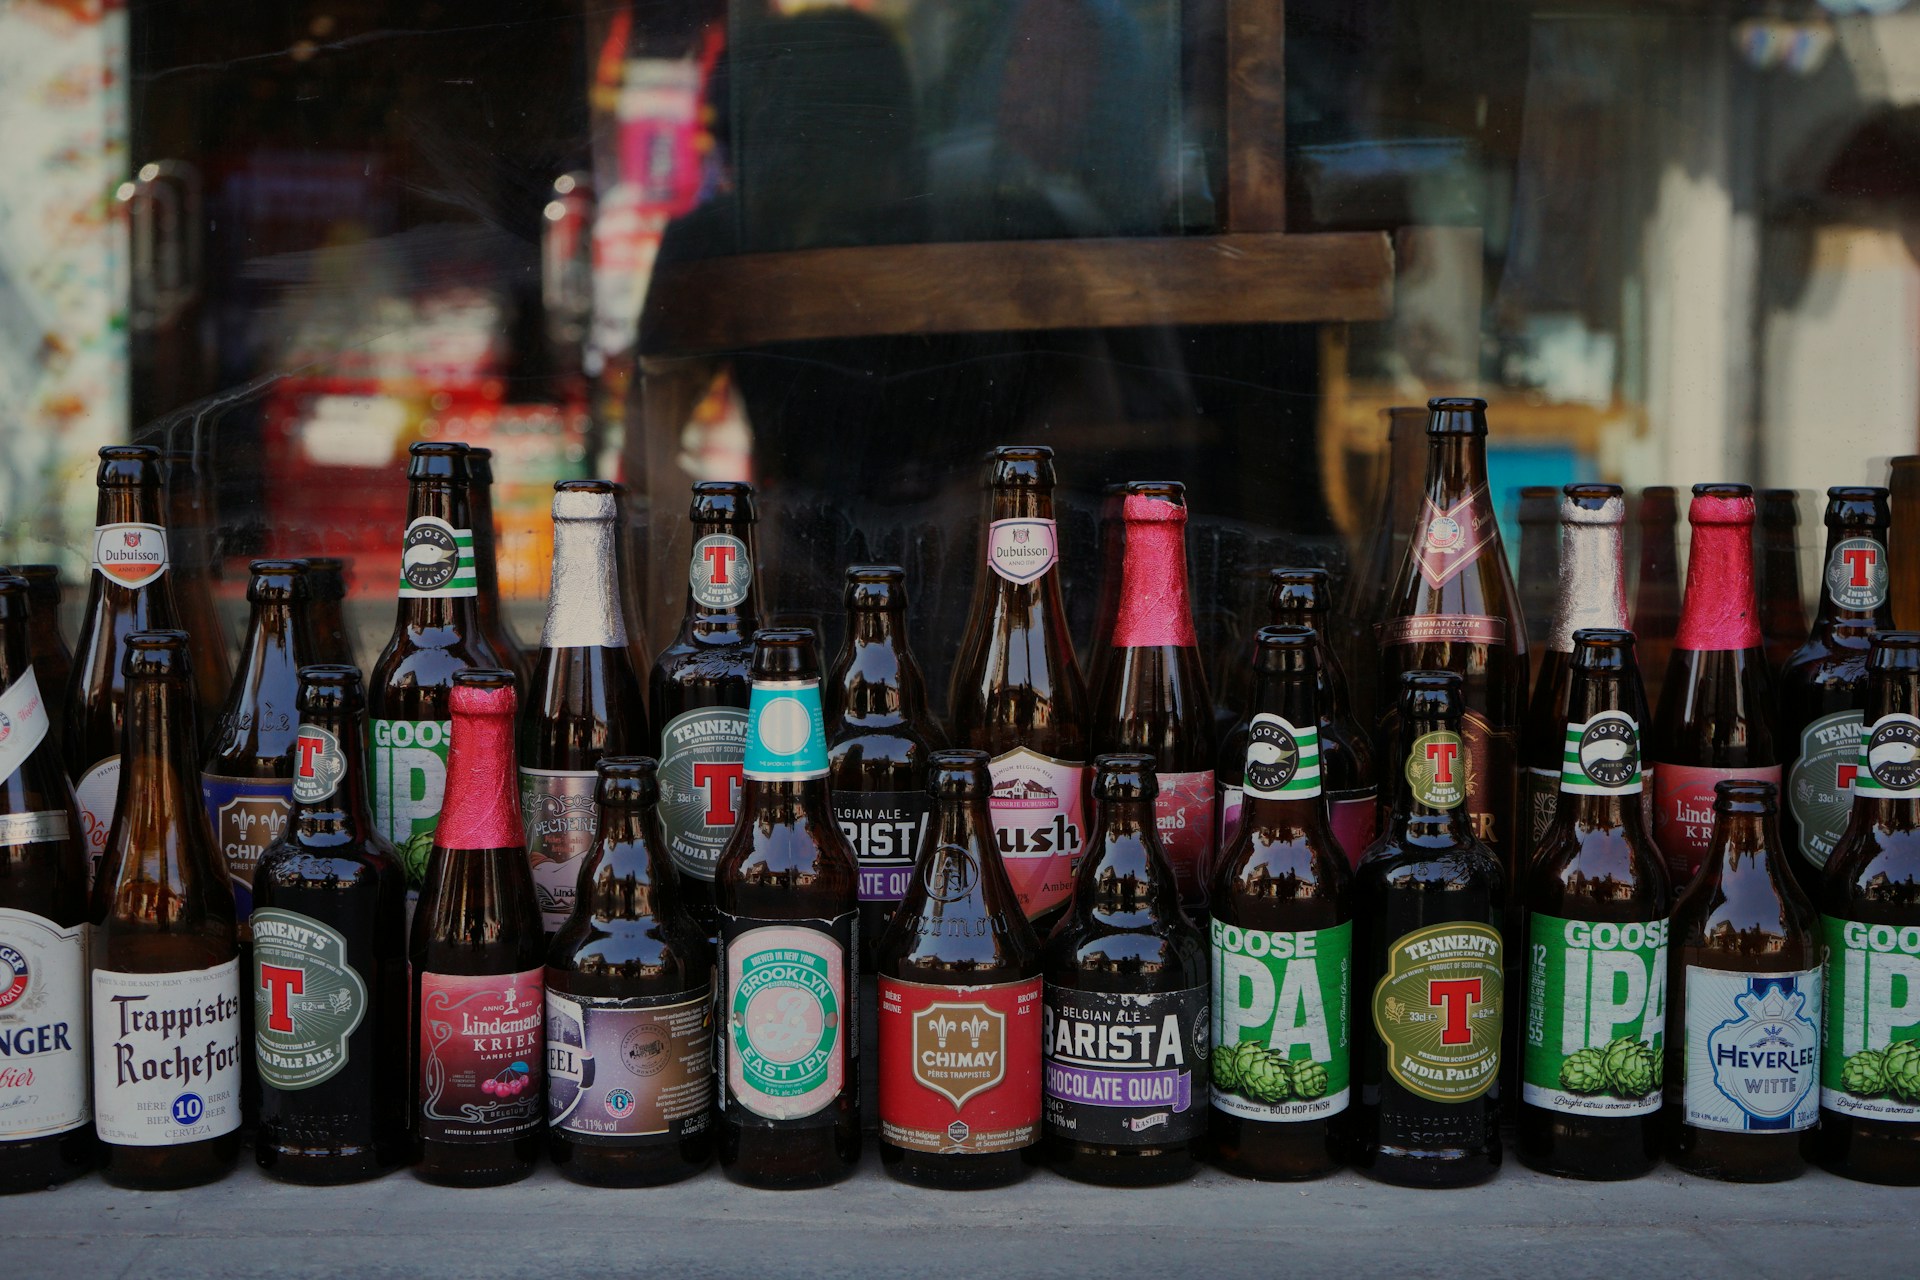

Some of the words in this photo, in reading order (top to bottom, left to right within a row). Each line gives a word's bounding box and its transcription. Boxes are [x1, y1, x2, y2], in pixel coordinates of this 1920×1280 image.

[410, 530, 448, 545] GOOSE
[105, 549, 159, 561] Dubuisson
[996, 546, 1048, 558] Dubuisson
[703, 546, 736, 584] T
[1843, 549, 1876, 587] T
[408, 569, 449, 585] ISLAND
[701, 593, 721, 603] PALE
[722, 593, 739, 603] ALE
[707, 586, 732, 595] INDIA
[1846, 588, 1872, 598] INDIA
[1840, 594, 1861, 606] PALE
[1863, 595, 1879, 606] ALE
[1412, 620, 1481, 629] AROMATISCHER
[691, 734, 726, 745] AUTHENTIC
[1252, 728, 1287, 745] GOOSE
[1591, 724, 1631, 740] GOOSE
[1878, 728, 1920, 743] GOOSE
[297, 736, 324, 778] T
[692, 746, 715, 755] PRODUCT
[1426, 743, 1457, 784] T
[1250, 767, 1288, 786] ISLAND
[1590, 764, 1634, 782] ISLAND
[375, 747, 448, 846] IP
[677, 792, 692, 803] 33cl
[692, 762, 744, 827] T
[1424, 791, 1446, 803] PALE
[1447, 791, 1461, 803] ALE
[1431, 786, 1456, 794] INDIA
[1818, 793, 1833, 803] 33cl
[877, 808, 902, 820] ALE
[684, 830, 714, 843] PREMIUM
[996, 814, 1081, 853] ush
[672, 835, 708, 861] INDIA
[1211, 916, 1318, 959] GOOSE
[1563, 916, 1670, 951] GOOSE
[282, 937, 307, 950] EXPORT
[1404, 934, 1499, 961] TENNENT'S
[281, 949, 305, 961] SCOTLAND
[750, 952, 775, 967] BREWED
[774, 951, 783, 960] IN
[783, 951, 800, 961] NEW
[800, 953, 817, 967] YORK
[1427, 950, 1464, 961] AUTHENTIC
[1463, 950, 1485, 959] EXPORT
[1532, 943, 1548, 967] 12
[1429, 961, 1453, 972] PRODUCT
[1453, 961, 1461, 970] OF
[1461, 960, 1483, 970] SCOTLAND
[740, 966, 831, 1000] BROOKLYN
[261, 962, 305, 1034] T
[1017, 991, 1039, 1004] BROWN
[1211, 947, 1333, 1063] IPA
[110, 993, 239, 1041] Trappistes
[1017, 1006, 1031, 1016] ALE
[1063, 1006, 1111, 1022] BELGIAN
[1115, 1008, 1141, 1023] ALE
[1409, 1011, 1426, 1022] 33cl
[1430, 979, 1483, 1046] T
[1529, 1006, 1545, 1022] ALE
[461, 1003, 542, 1036] Lindemans
[1043, 1003, 1185, 1067] BARISTA
[1528, 1021, 1544, 1043] 55
[303, 1040, 317, 1049] ALE
[473, 1031, 536, 1052] KRIEK
[112, 1035, 240, 1089] Rochefort
[272, 1053, 304, 1069] PALE
[304, 1048, 335, 1068] ALE
[481, 1052, 513, 1061] LAMBIC
[515, 1048, 532, 1058] BEER
[741, 1046, 791, 1079] EAST
[797, 1048, 829, 1077] IPA
[921, 1050, 998, 1068] CHIMAY
[1417, 1050, 1450, 1063] PREMIUM
[1450, 1052, 1480, 1063] SCOTTISH
[1479, 1046, 1489, 1057] ALE
[1717, 1043, 1814, 1074] HEVERLEE
[927, 1069, 948, 1078] PÈRES
[950, 1070, 991, 1079] TRAPPISTES
[1400, 1055, 1445, 1081] INDIA
[1445, 1066, 1480, 1082] PALE
[1479, 1051, 1498, 1075] ALE
[1046, 1066, 1123, 1102] CHOCOLATE
[1128, 1077, 1174, 1101] QUAD
[1744, 1077, 1797, 1094] WITTE
[208, 1090, 231, 1104] BIRRA
[1553, 1095, 1583, 1110] Bright
[1583, 1100, 1604, 1110] citrus
[1604, 1102, 1631, 1111] aromas
[1638, 1097, 1652, 1108] BOLD
[1836, 1095, 1863, 1111] Bright
[1863, 1102, 1885, 1113] citrus
[1885, 1106, 1915, 1115] aromas
[175, 1098, 201, 1119] 10
[205, 1107, 227, 1119] BEER
[490, 1107, 524, 1118] BELGIUM
[1235, 1101, 1261, 1113] aromas
[1269, 1105, 1291, 1115] BOLD
[1291, 1104, 1308, 1115] HOP
[1308, 1100, 1330, 1114] FINISH
[147, 1115, 171, 1125] BIER
[571, 1117, 583, 1129] alc.
[584, 1118, 603, 1131] 11%
[603, 1119, 618, 1132] vol
[1053, 1112, 1066, 1128] 11%
[1066, 1116, 1078, 1130] vol
[1134, 1113, 1166, 1130] KASTEEL
[164, 1123, 211, 1139] CERVEZA
[915, 1129, 941, 1141] Belgique
